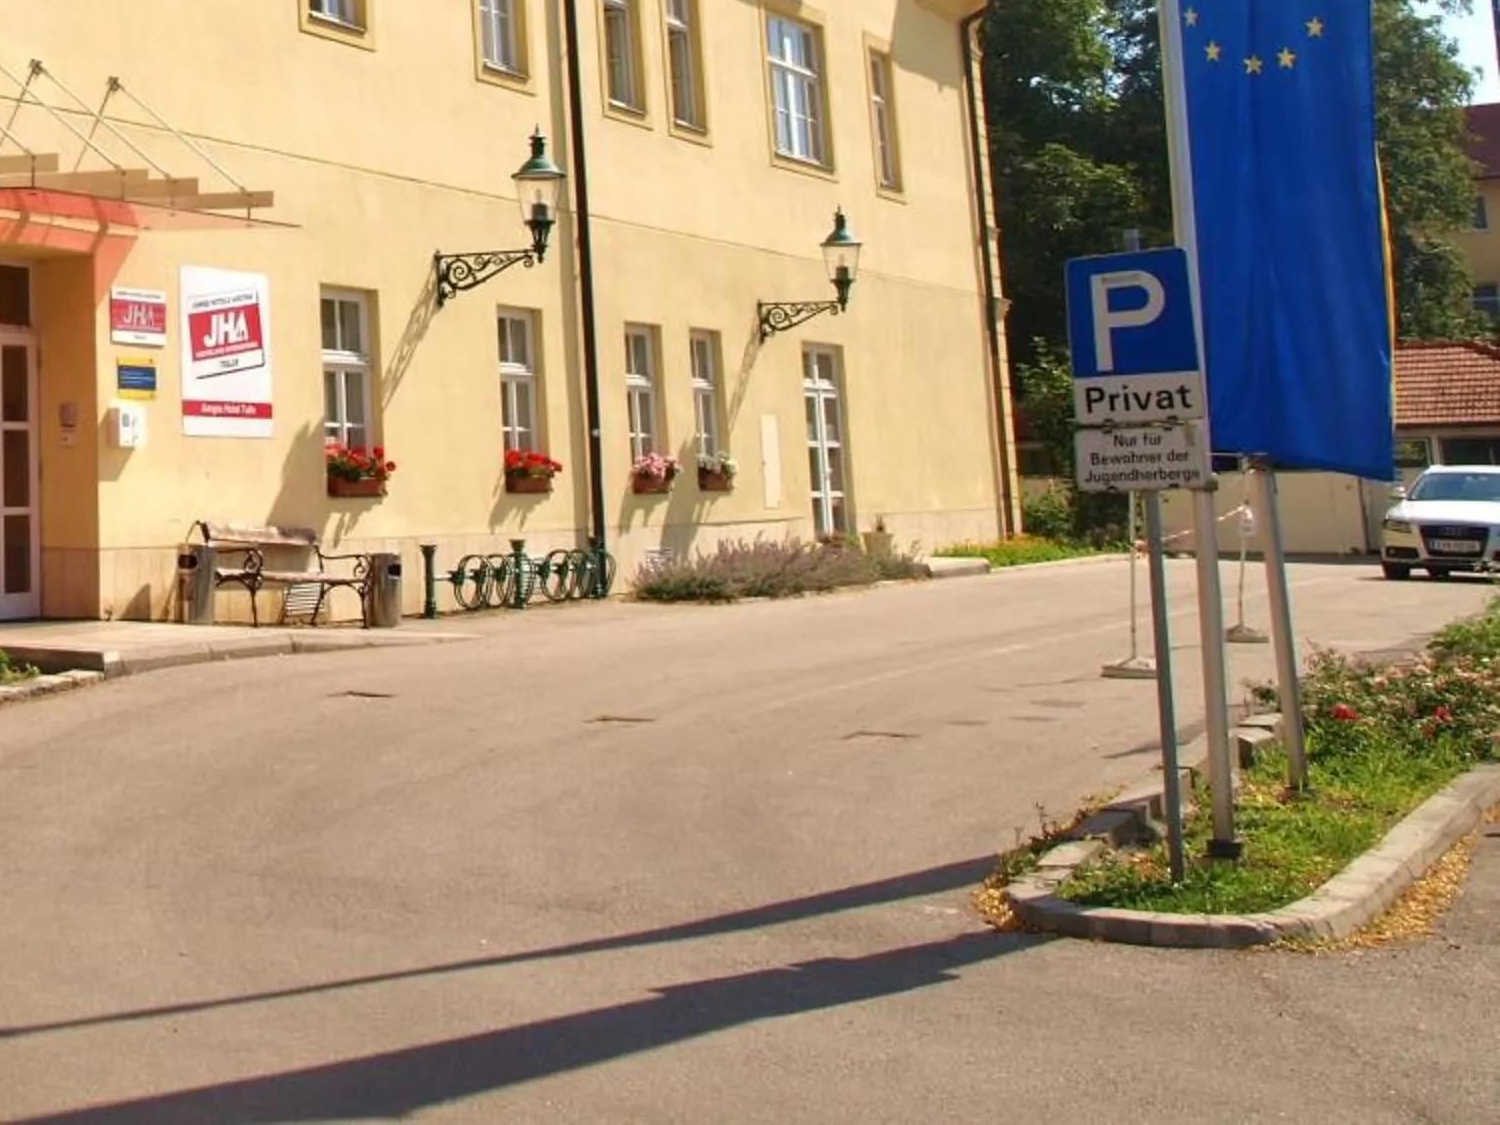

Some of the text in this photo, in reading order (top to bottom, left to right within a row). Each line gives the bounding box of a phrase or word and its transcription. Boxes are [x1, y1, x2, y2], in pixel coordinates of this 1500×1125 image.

[203, 310, 250, 347] JHA
[1090, 270, 1165, 372] P
[1085, 384, 1193, 414] Privat
[1113, 434, 1137, 447] Nur
[1090, 449, 1189, 466] Bewohner der
[1084, 466, 1200, 484] Jugendherberge
